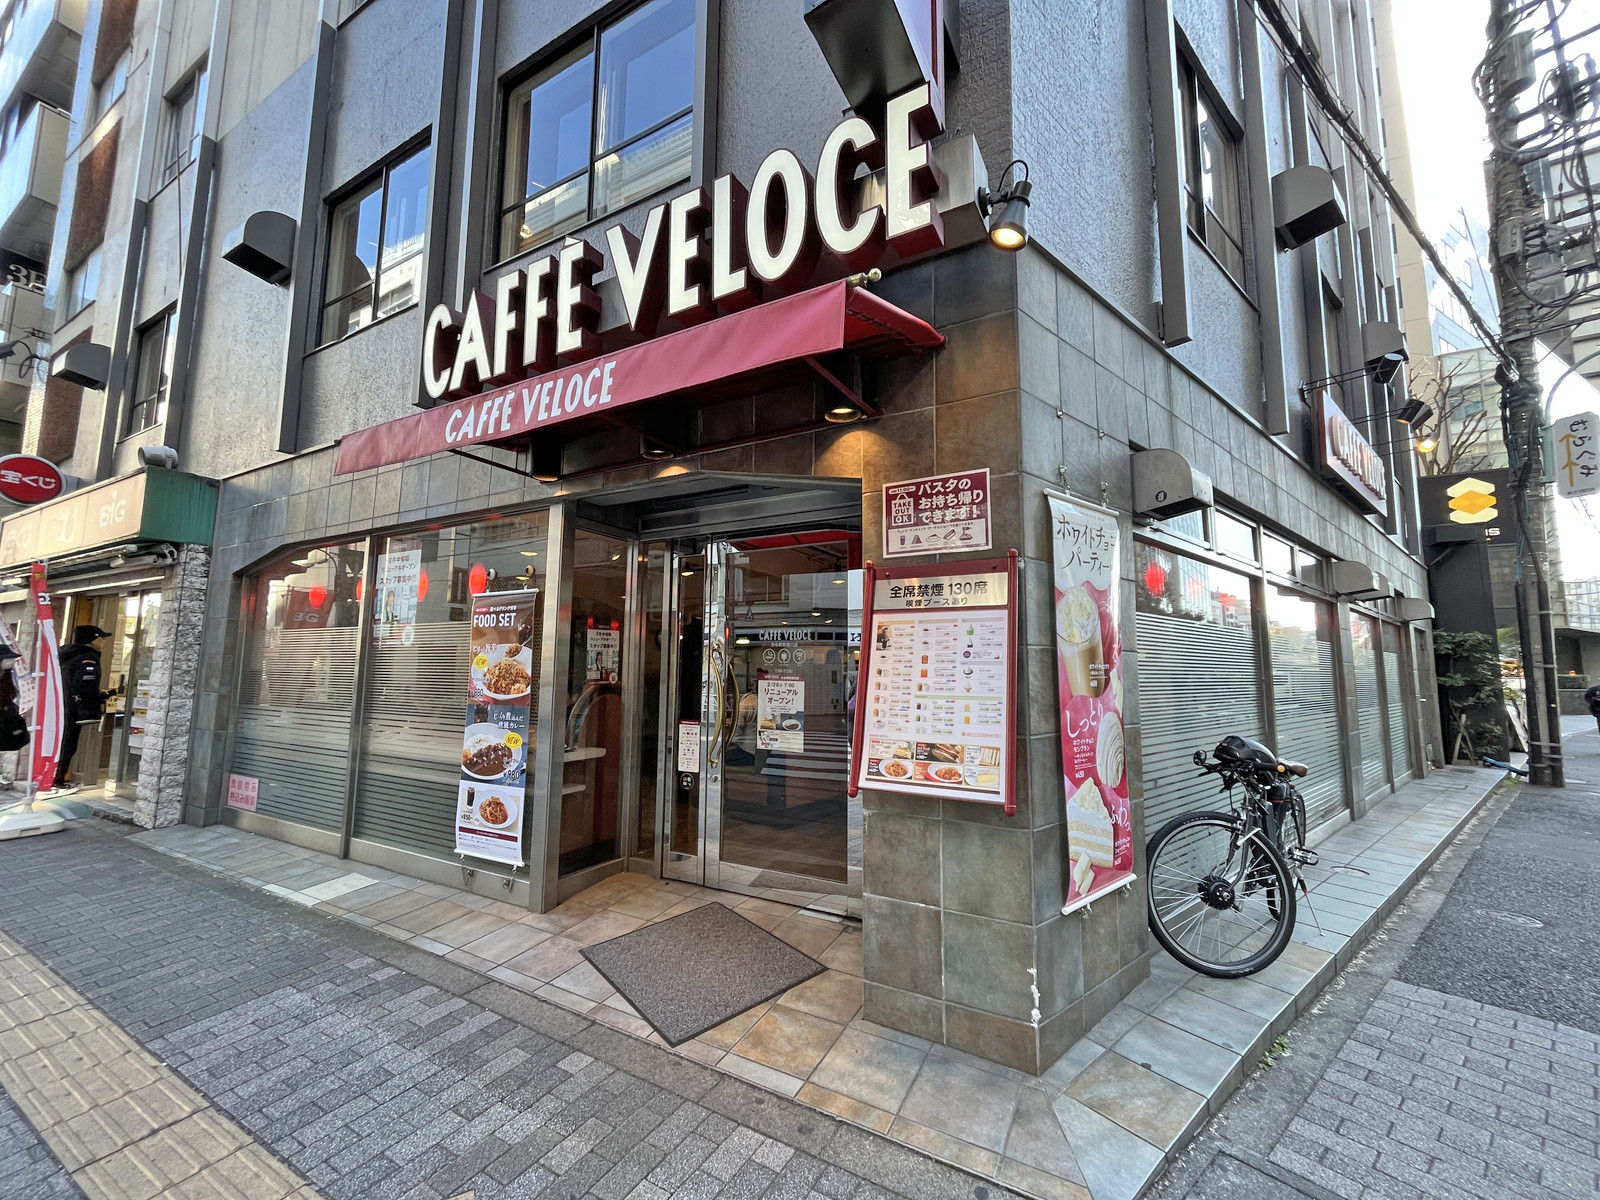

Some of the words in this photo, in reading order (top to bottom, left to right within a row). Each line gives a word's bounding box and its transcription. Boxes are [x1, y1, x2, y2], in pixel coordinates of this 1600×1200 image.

[422, 236, 587, 399] CAFFÈ
[605, 81, 934, 332] VELOCE
[445, 391, 513, 445] CAFFÈ
[522, 361, 617, 426] VELOCE
[0, 469, 56, 489] 宝くじ
[917, 478, 972, 496] パスタの
[893, 500, 912, 509] TAKE
[918, 489, 984, 509] お持ち帰り
[895, 515, 909, 523] OK
[889, 583, 945, 599] 全席禁煙
[947, 581, 989, 596] 130席
[905, 596, 968, 608] 喫煙ブースあり
[473, 613, 497, 628] FOOD
[498, 612, 517, 627] SET
[783, 629, 812, 641] VELOCE
[764, 687, 799, 696] リニューアル
[506, 734, 521, 746] NEW
